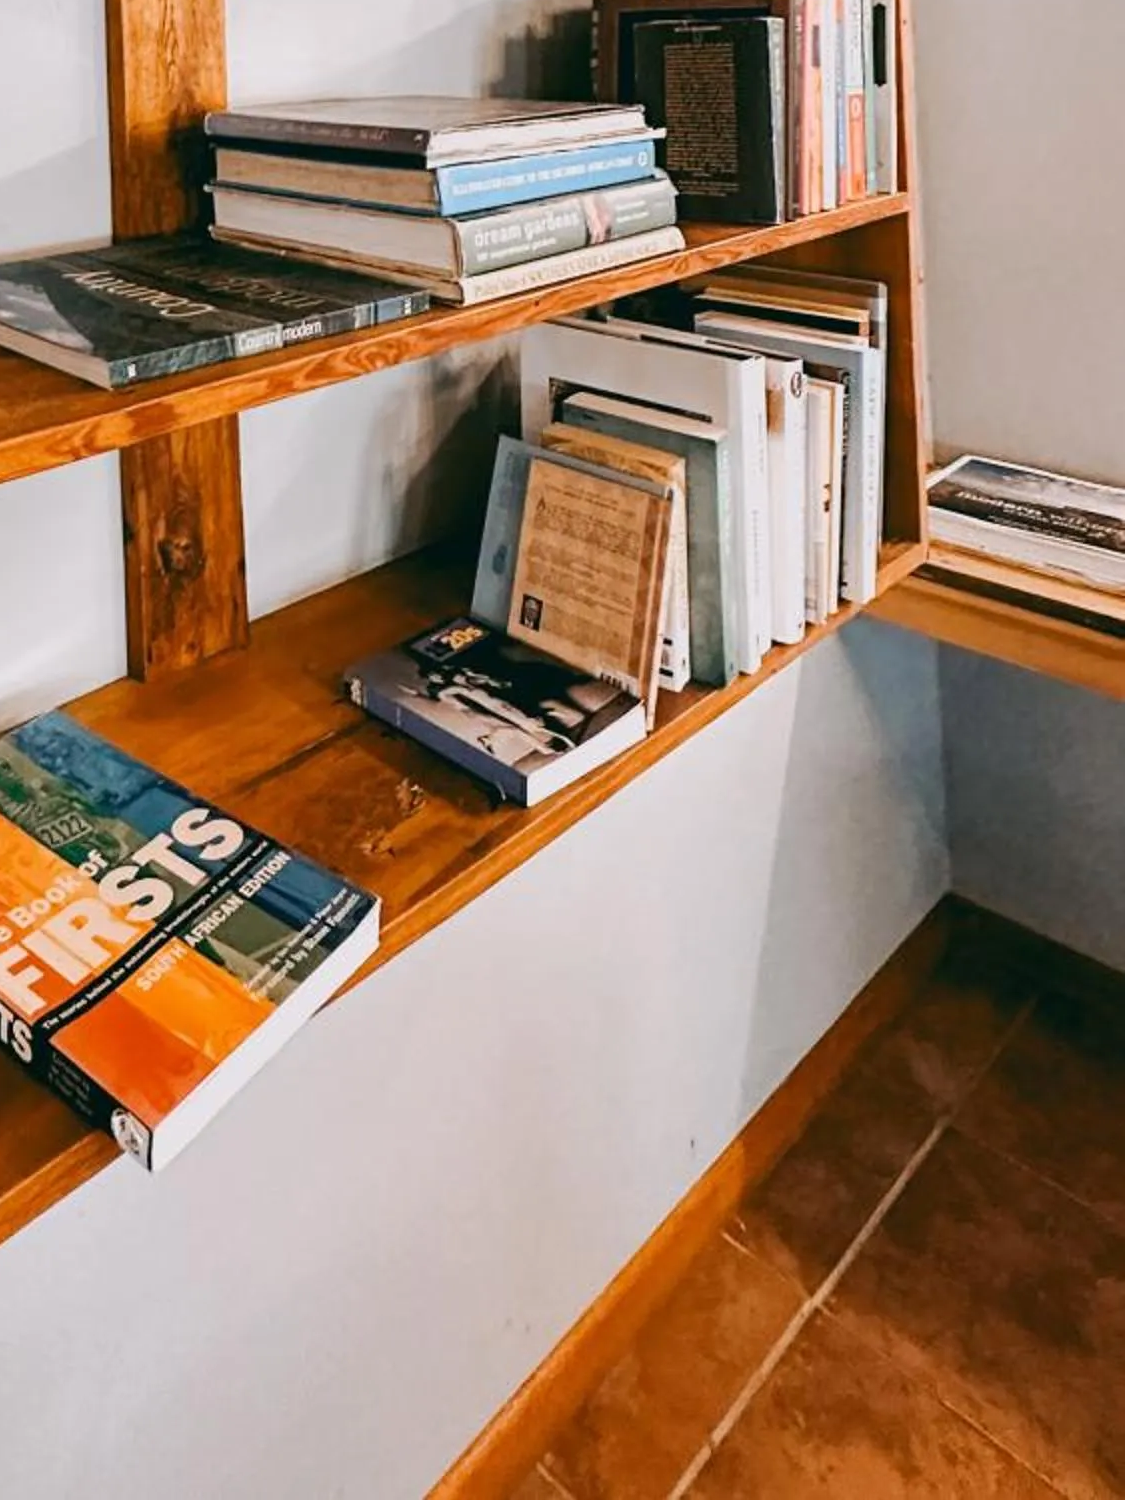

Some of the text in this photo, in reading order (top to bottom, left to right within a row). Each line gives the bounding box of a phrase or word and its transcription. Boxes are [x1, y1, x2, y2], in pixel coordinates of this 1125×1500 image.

[475, 223, 522, 248] dream
[524, 208, 582, 240] gardens
[60, 270, 216, 317] Country
[282, 319, 323, 342] modern
[6, 872, 82, 930] Book
[78, 848, 109, 878] of
[135, 942, 188, 993] SOUTH
[183, 895, 244, 948] AFRICAN
[238, 850, 292, 898] EDITION
